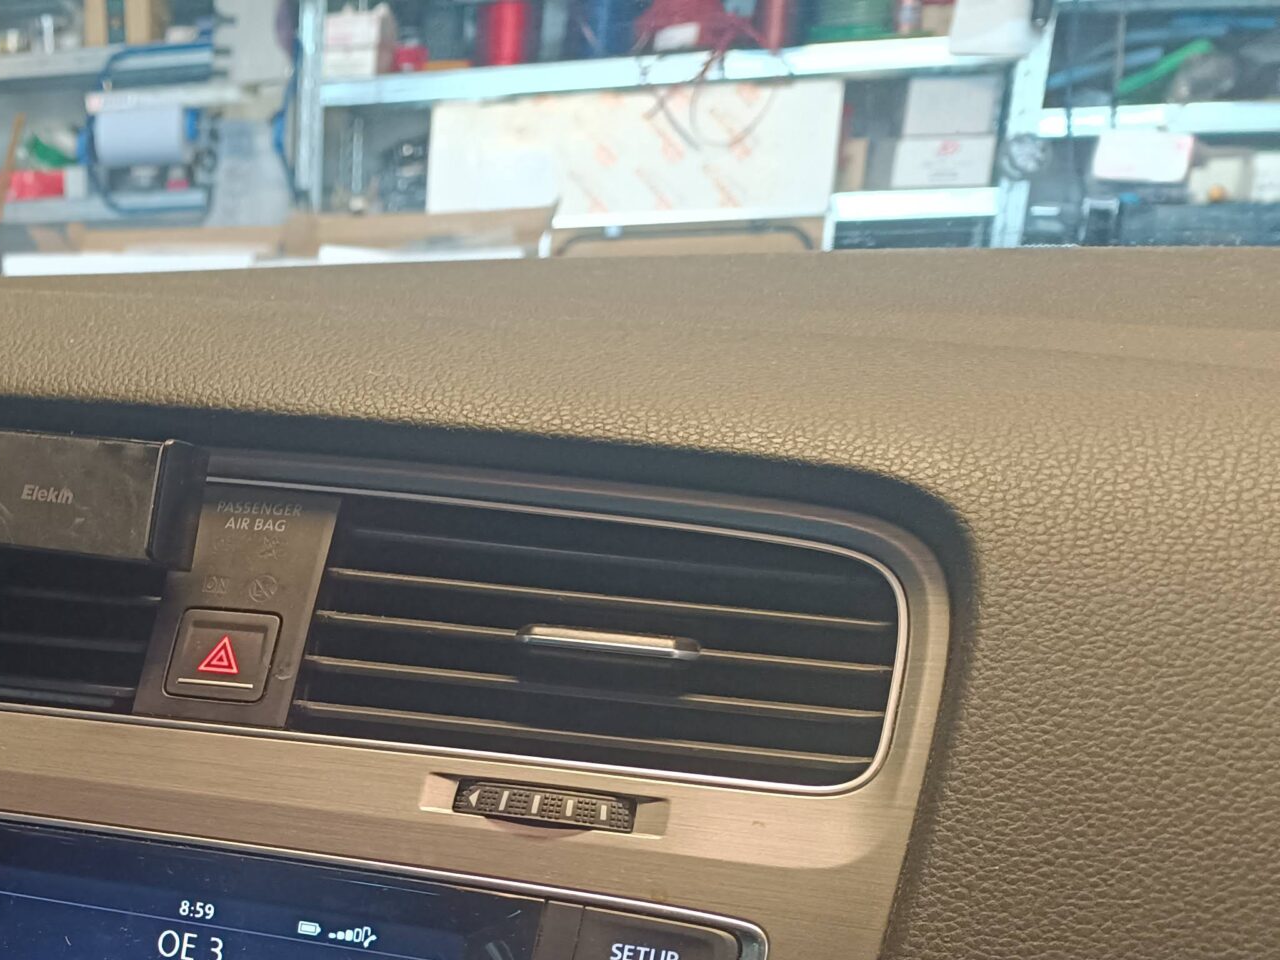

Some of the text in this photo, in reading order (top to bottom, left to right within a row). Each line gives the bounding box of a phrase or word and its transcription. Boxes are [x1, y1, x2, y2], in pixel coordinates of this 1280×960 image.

[216, 500, 303, 517] PASSENGER
[224, 517, 287, 532] AIR BAG
[179, 900, 215, 920] 8:59
